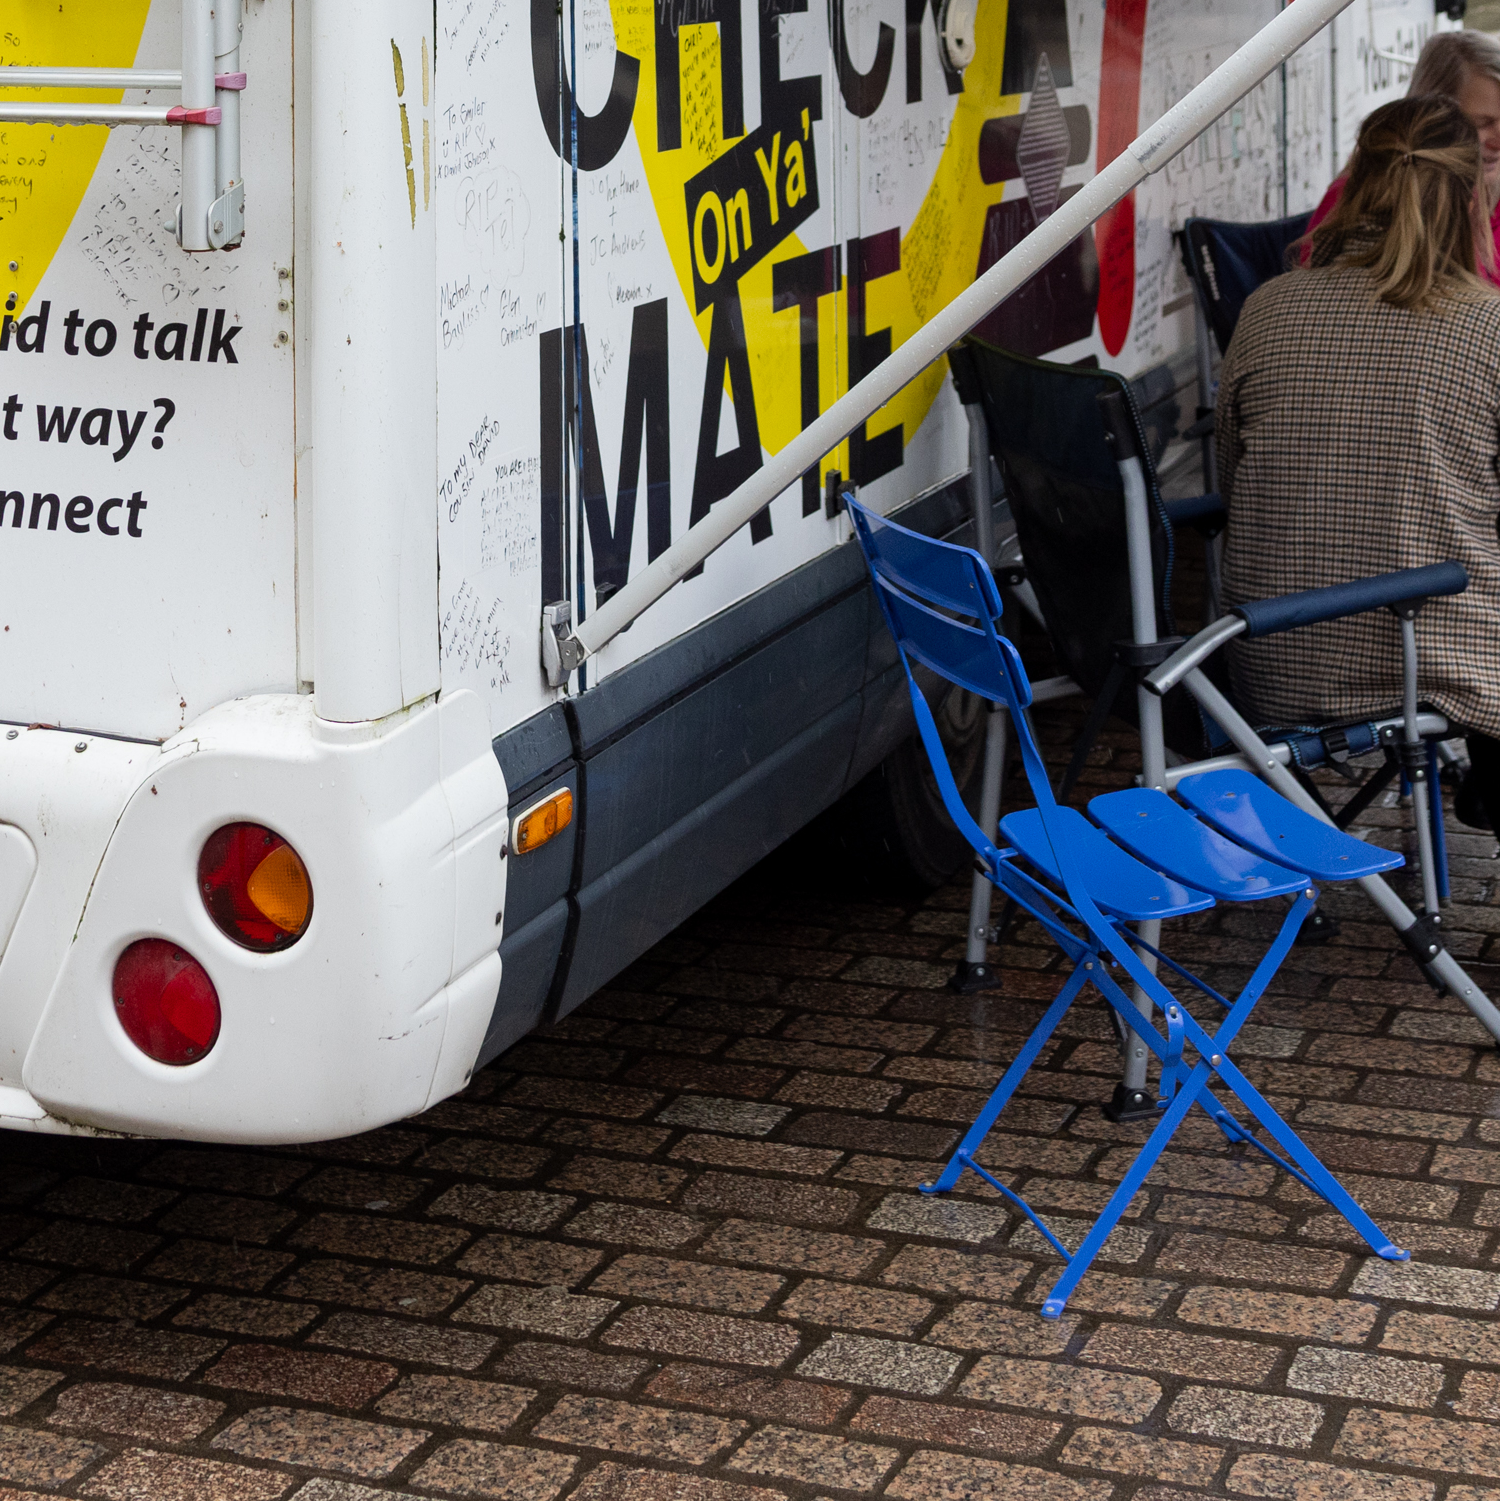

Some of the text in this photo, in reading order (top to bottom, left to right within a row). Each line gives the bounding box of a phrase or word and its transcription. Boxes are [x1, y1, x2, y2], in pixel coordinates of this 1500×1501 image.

[693, 177, 749, 285] On
[63, 310, 117, 358] to
[132, 308, 243, 364] talk
[37, 397, 177, 463] way?
[539, 228, 905, 600] MATE
